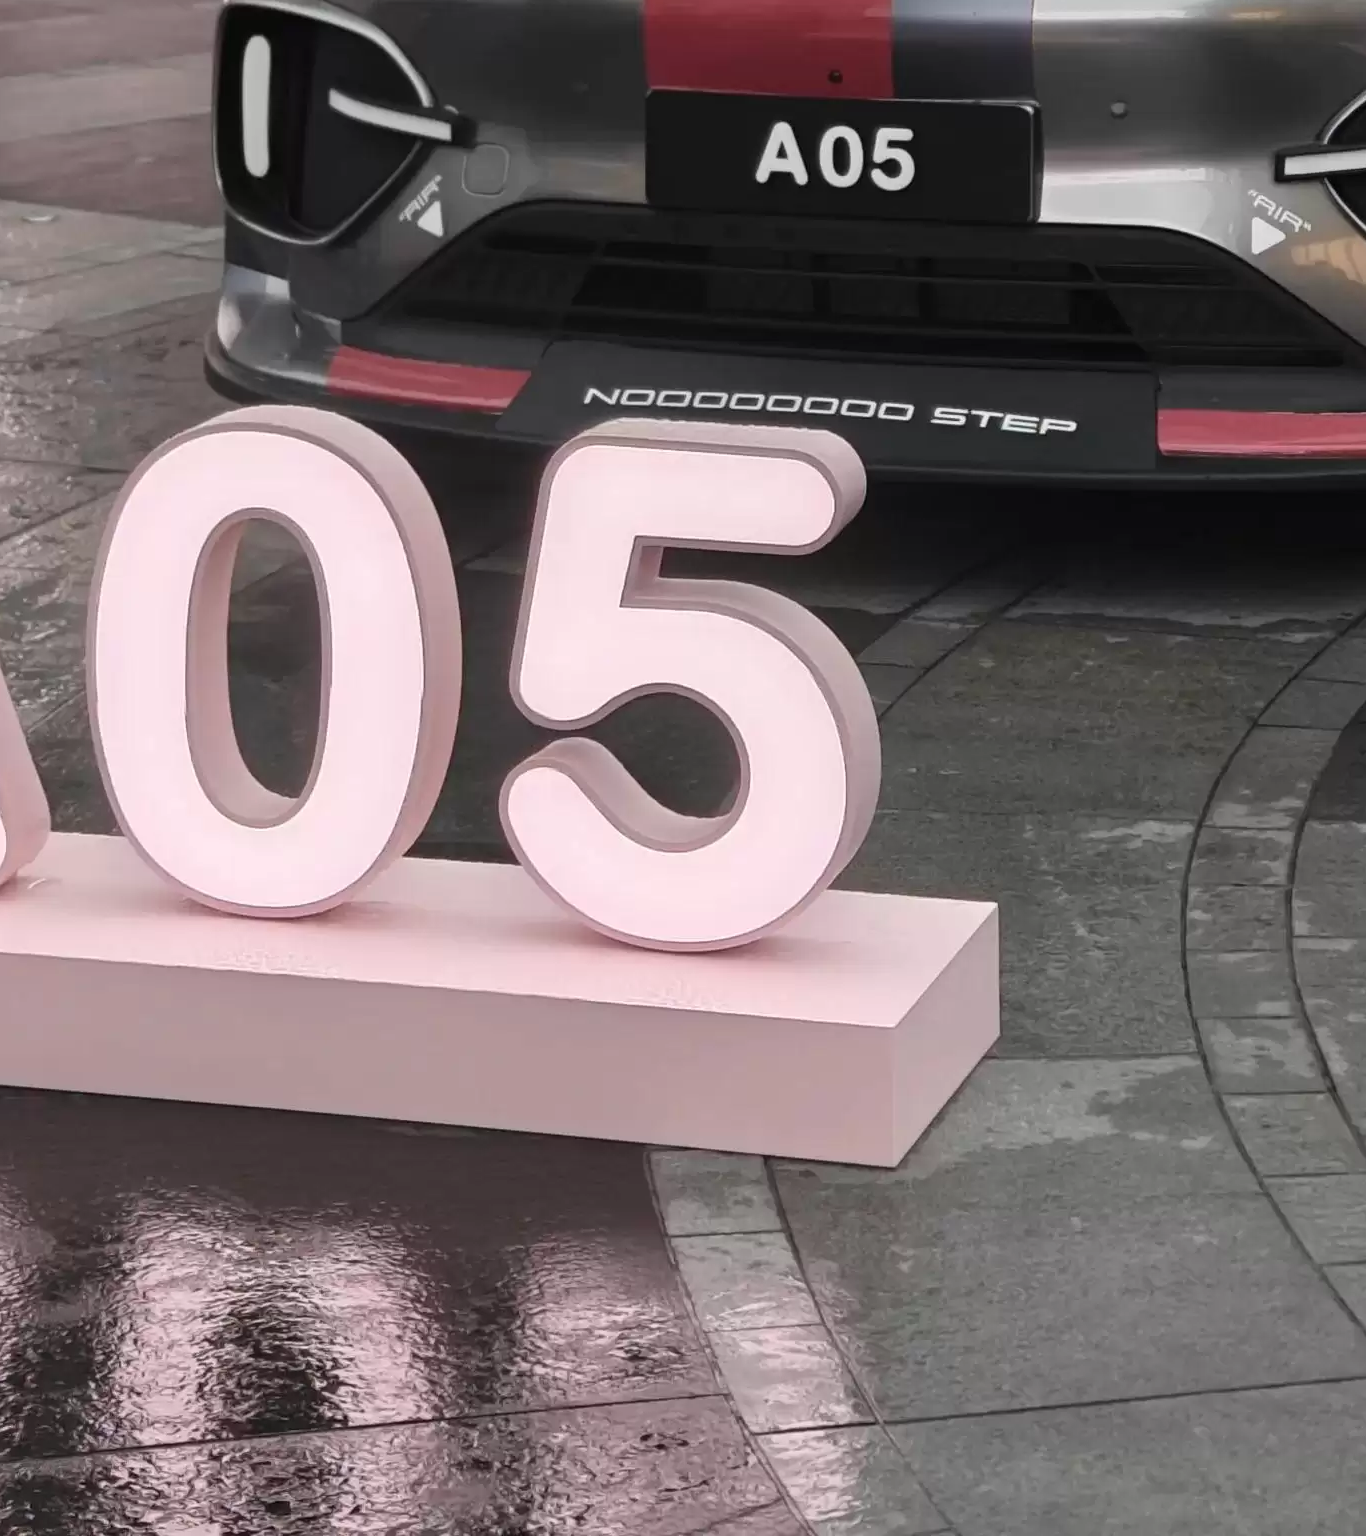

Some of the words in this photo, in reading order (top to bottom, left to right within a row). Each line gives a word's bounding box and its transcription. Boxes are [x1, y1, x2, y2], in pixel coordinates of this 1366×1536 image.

[755, 121, 916, 191] A05
[584, 387, 915, 422] NOOOOOOOO
[930, 407, 1078, 436] STEP
